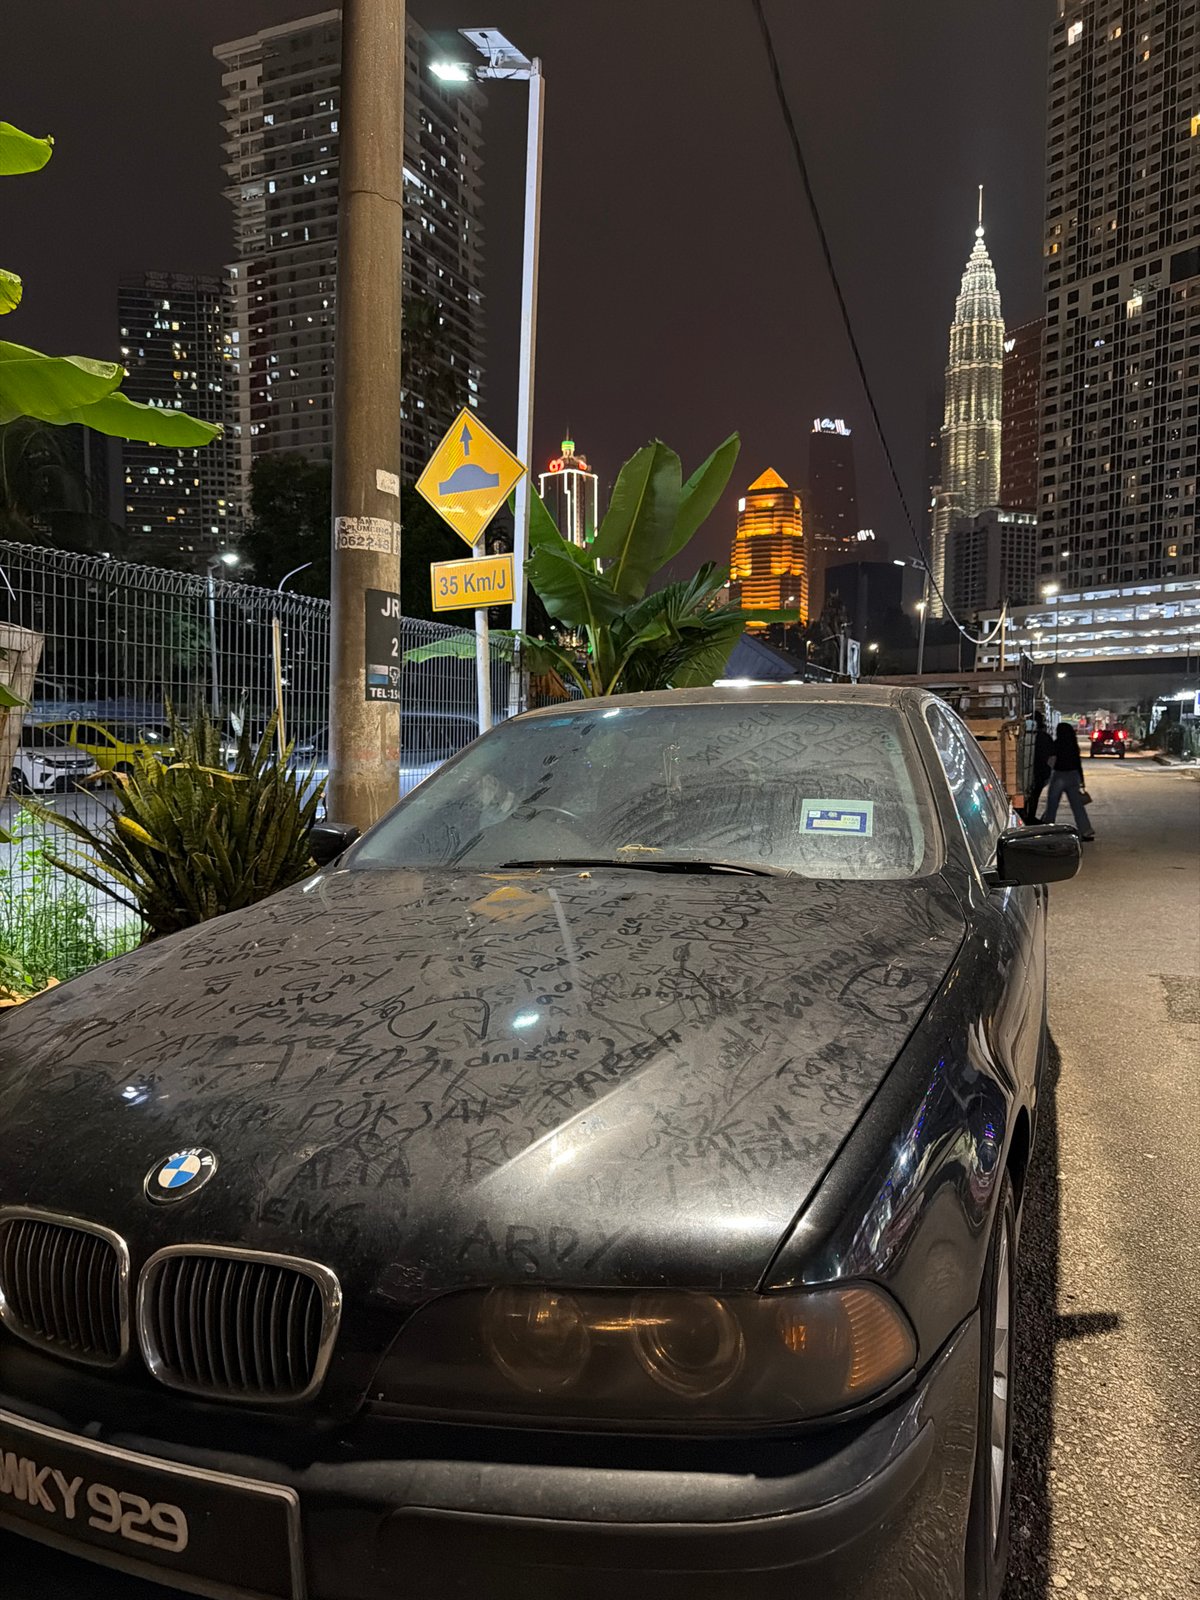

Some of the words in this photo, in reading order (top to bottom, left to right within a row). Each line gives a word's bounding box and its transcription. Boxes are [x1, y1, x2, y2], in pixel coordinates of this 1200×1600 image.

[439, 574, 460, 597] 35
[464, 569, 507, 593] Km/J
[87, 1483, 188, 1552] 929
